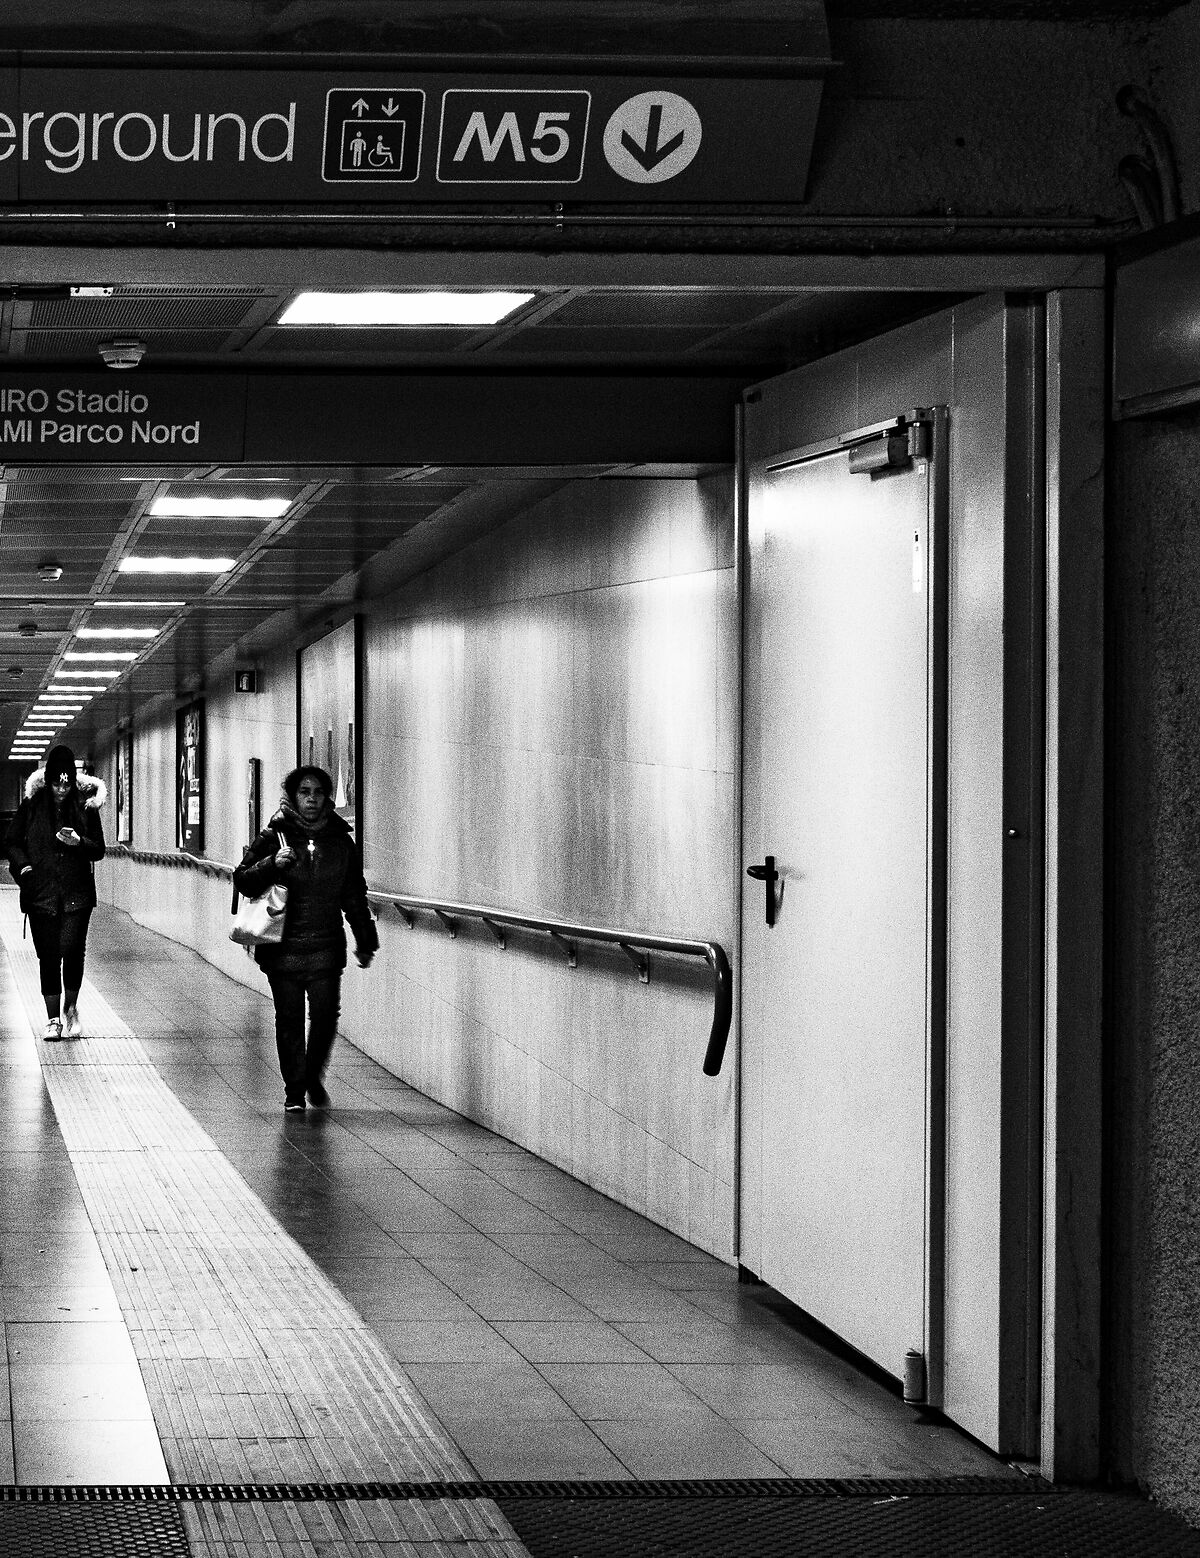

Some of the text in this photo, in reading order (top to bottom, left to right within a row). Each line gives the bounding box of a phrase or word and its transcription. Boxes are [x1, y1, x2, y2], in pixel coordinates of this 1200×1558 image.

[453, 111, 571, 162] M5
[56, 389, 149, 413] Stadio
[40, 420, 123, 444] Parco
[131, 420, 200, 444] Nord
